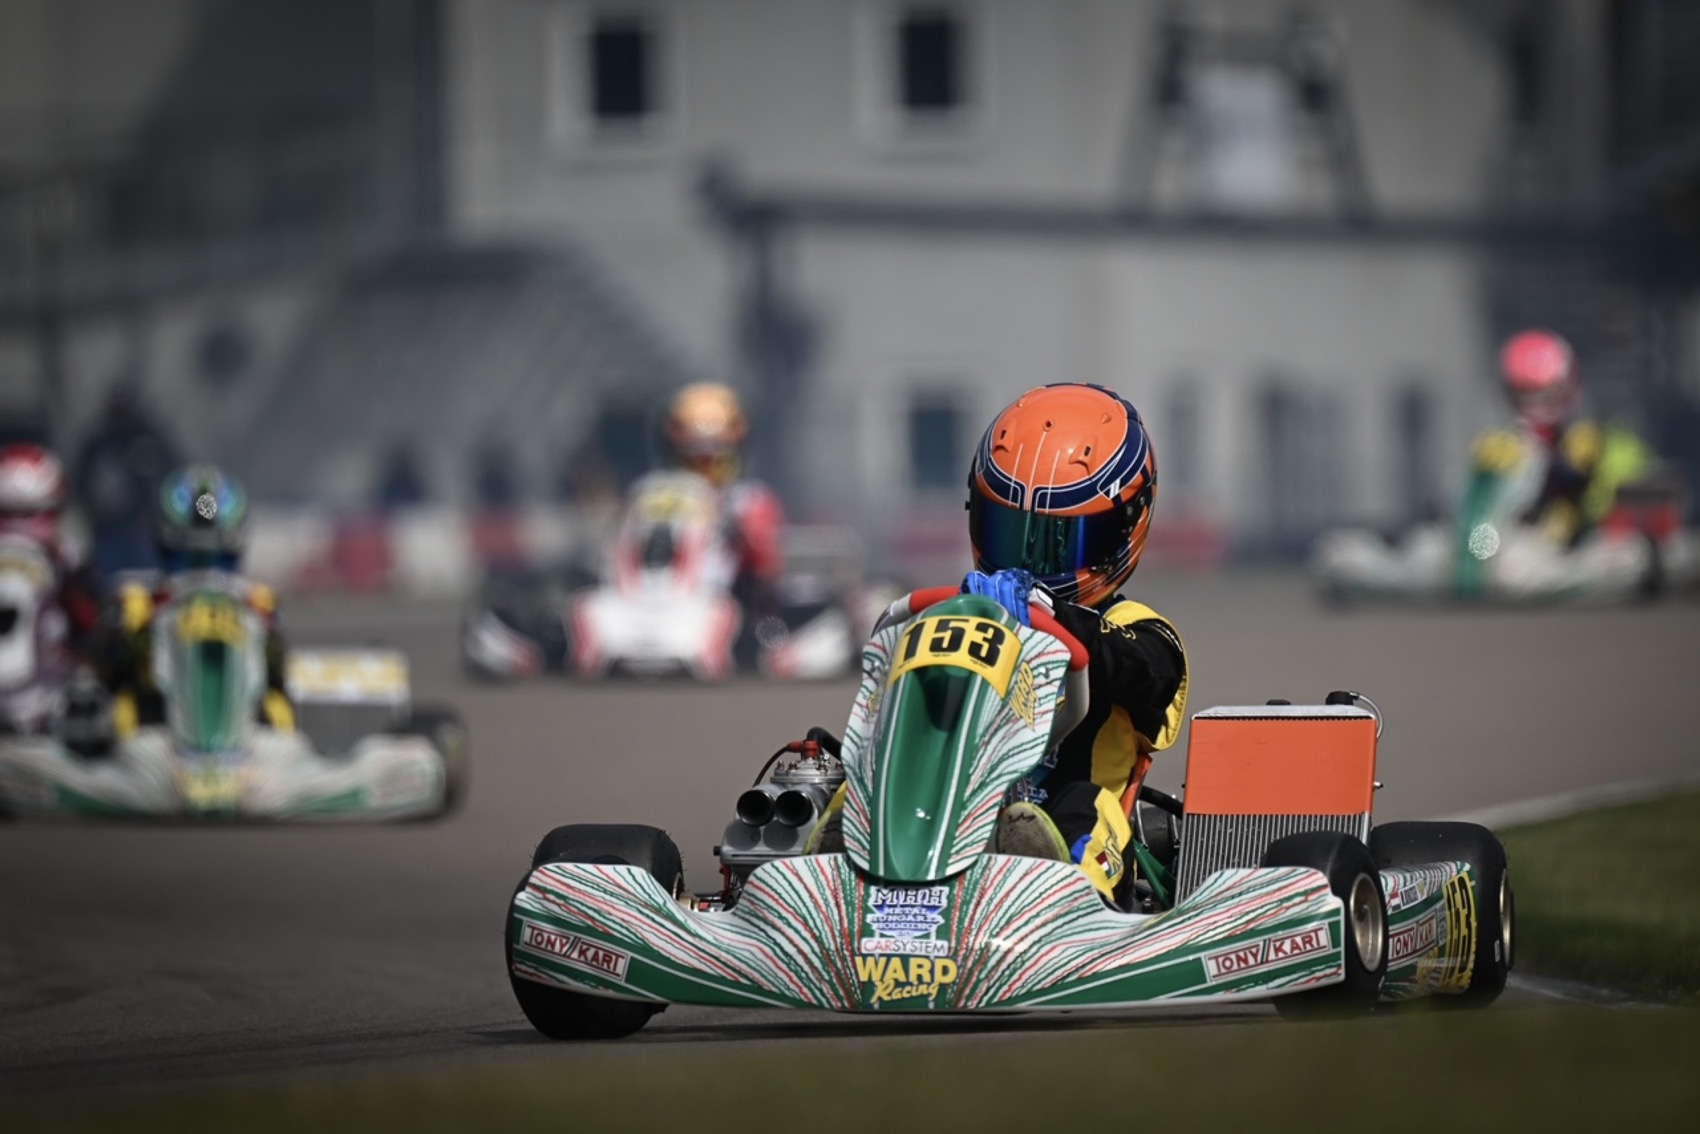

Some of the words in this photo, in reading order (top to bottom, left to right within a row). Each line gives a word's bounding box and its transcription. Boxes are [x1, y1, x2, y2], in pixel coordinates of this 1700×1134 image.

[903, 618, 1006, 667] 153
[863, 939, 946, 954] CARSYSTEM
[854, 956, 958, 983] WARD
[870, 978, 940, 1003] Racing
